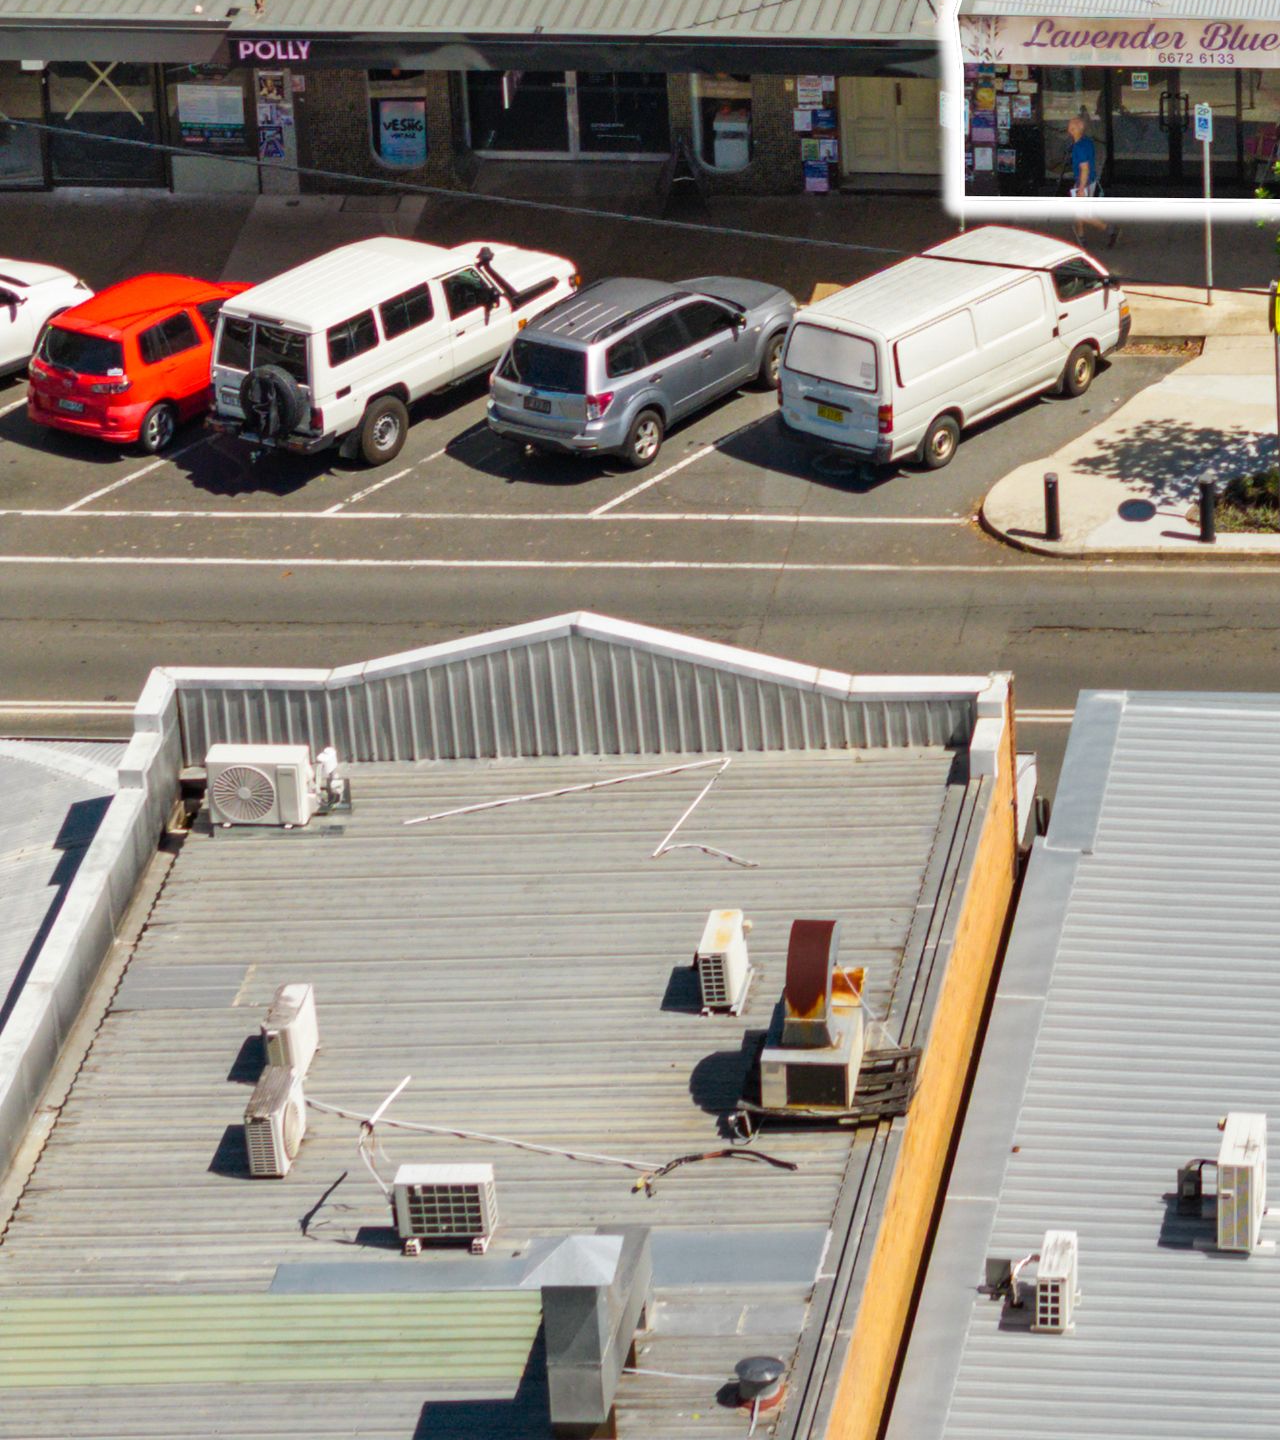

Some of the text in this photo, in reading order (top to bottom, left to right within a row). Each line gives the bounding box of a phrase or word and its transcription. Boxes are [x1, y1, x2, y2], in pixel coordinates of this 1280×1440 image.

[1022, 18, 1280, 52] Lavender Blue
[238, 40, 312, 60] POLLY
[1158, 52, 1235, 65] 6672 6133
